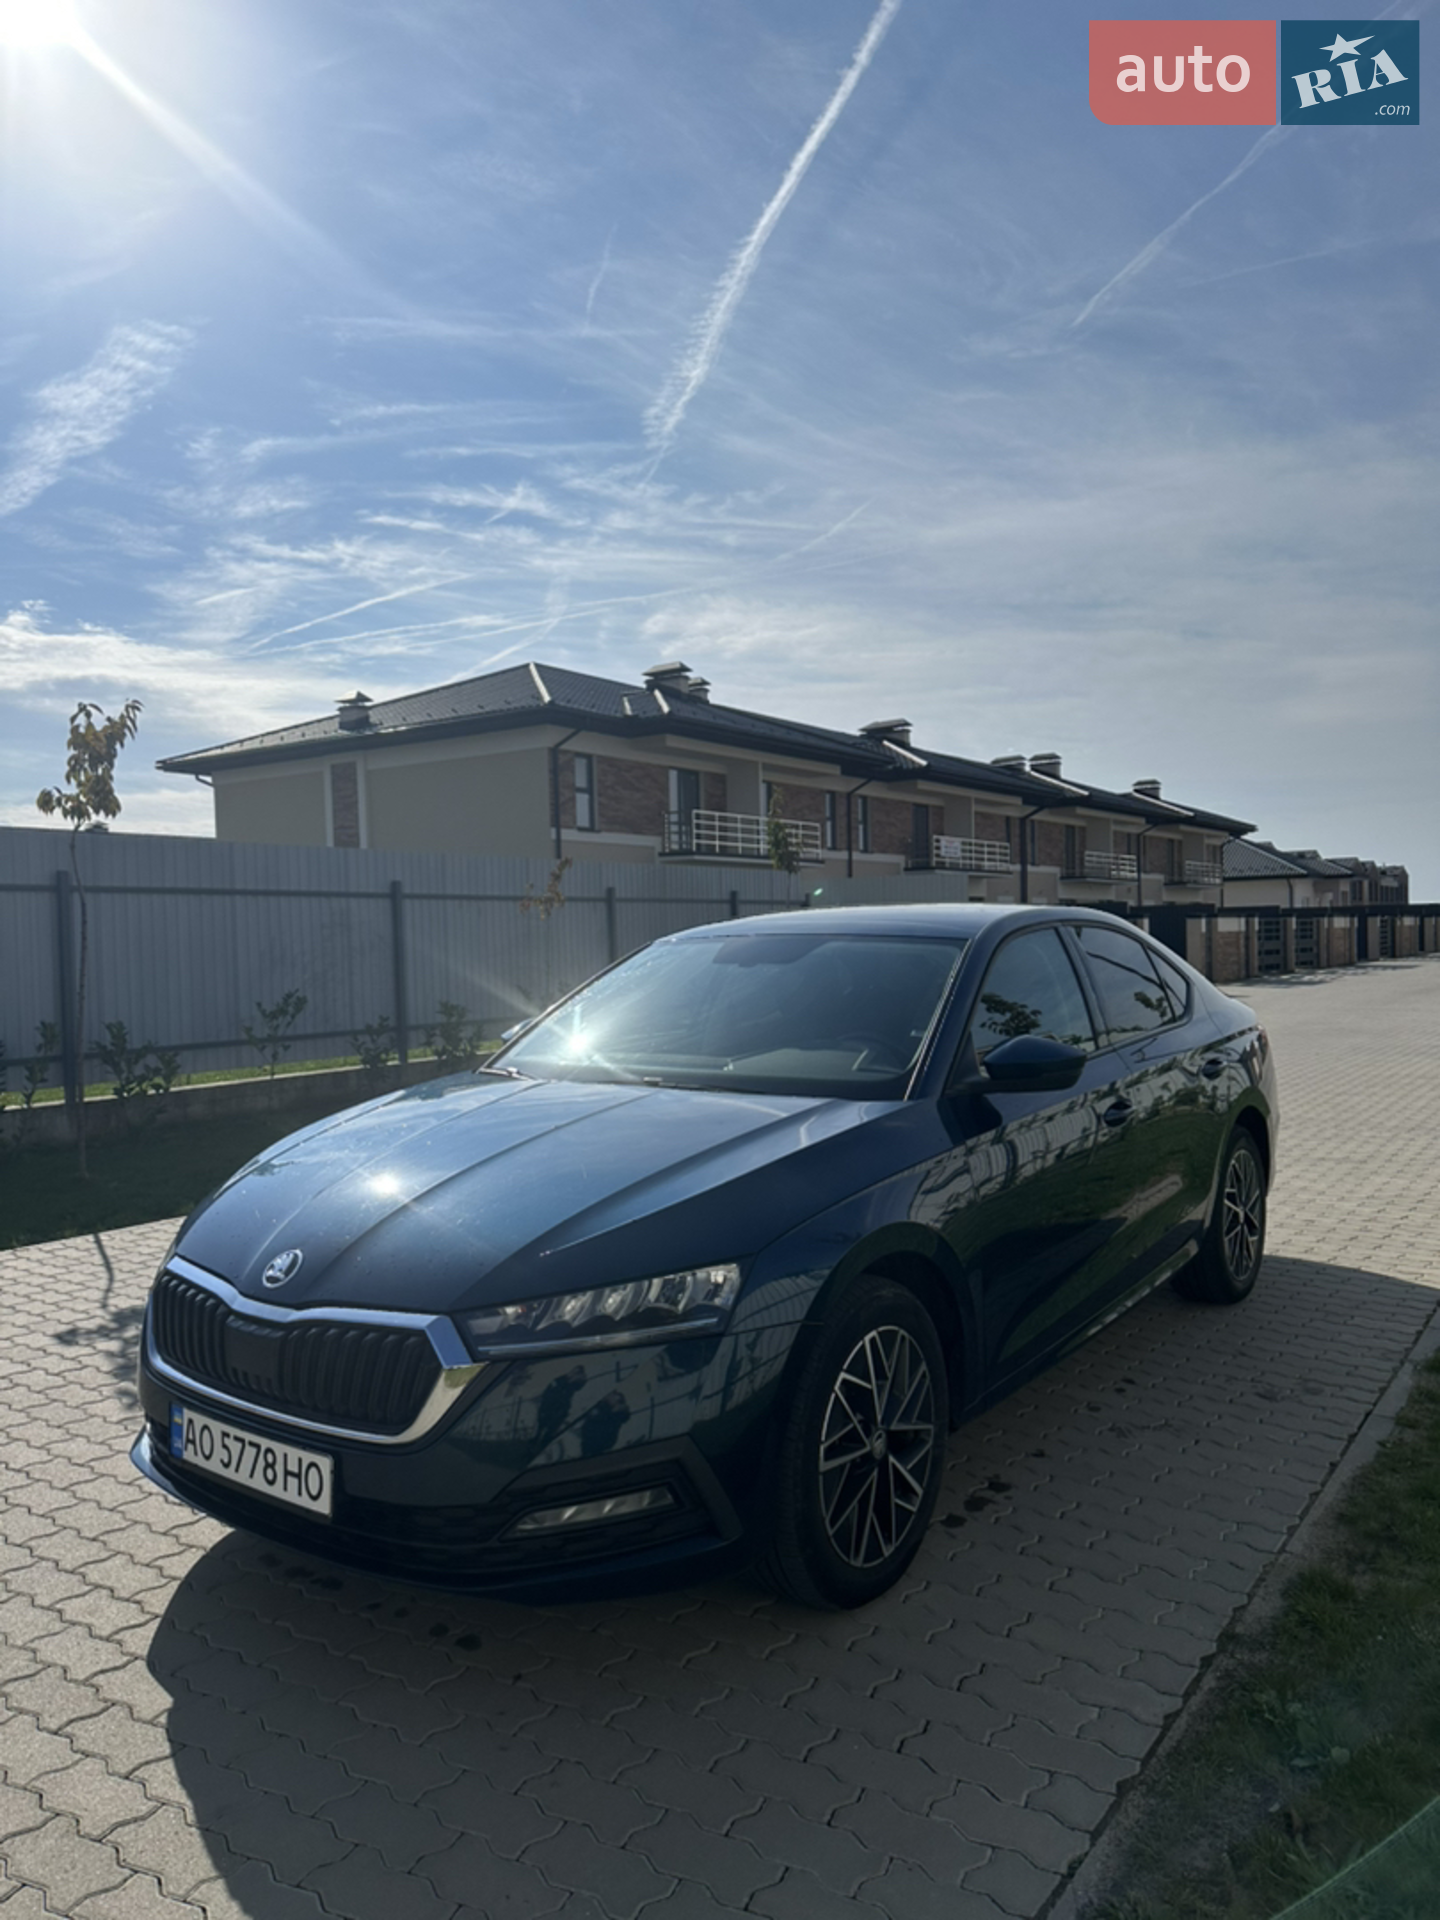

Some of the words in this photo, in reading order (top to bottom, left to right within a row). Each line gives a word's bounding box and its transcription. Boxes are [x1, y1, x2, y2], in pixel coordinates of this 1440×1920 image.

[184, 1417, 215, 1461] AO
[219, 1430, 278, 1487] 5778
[283, 1452, 324, 1502] HO
